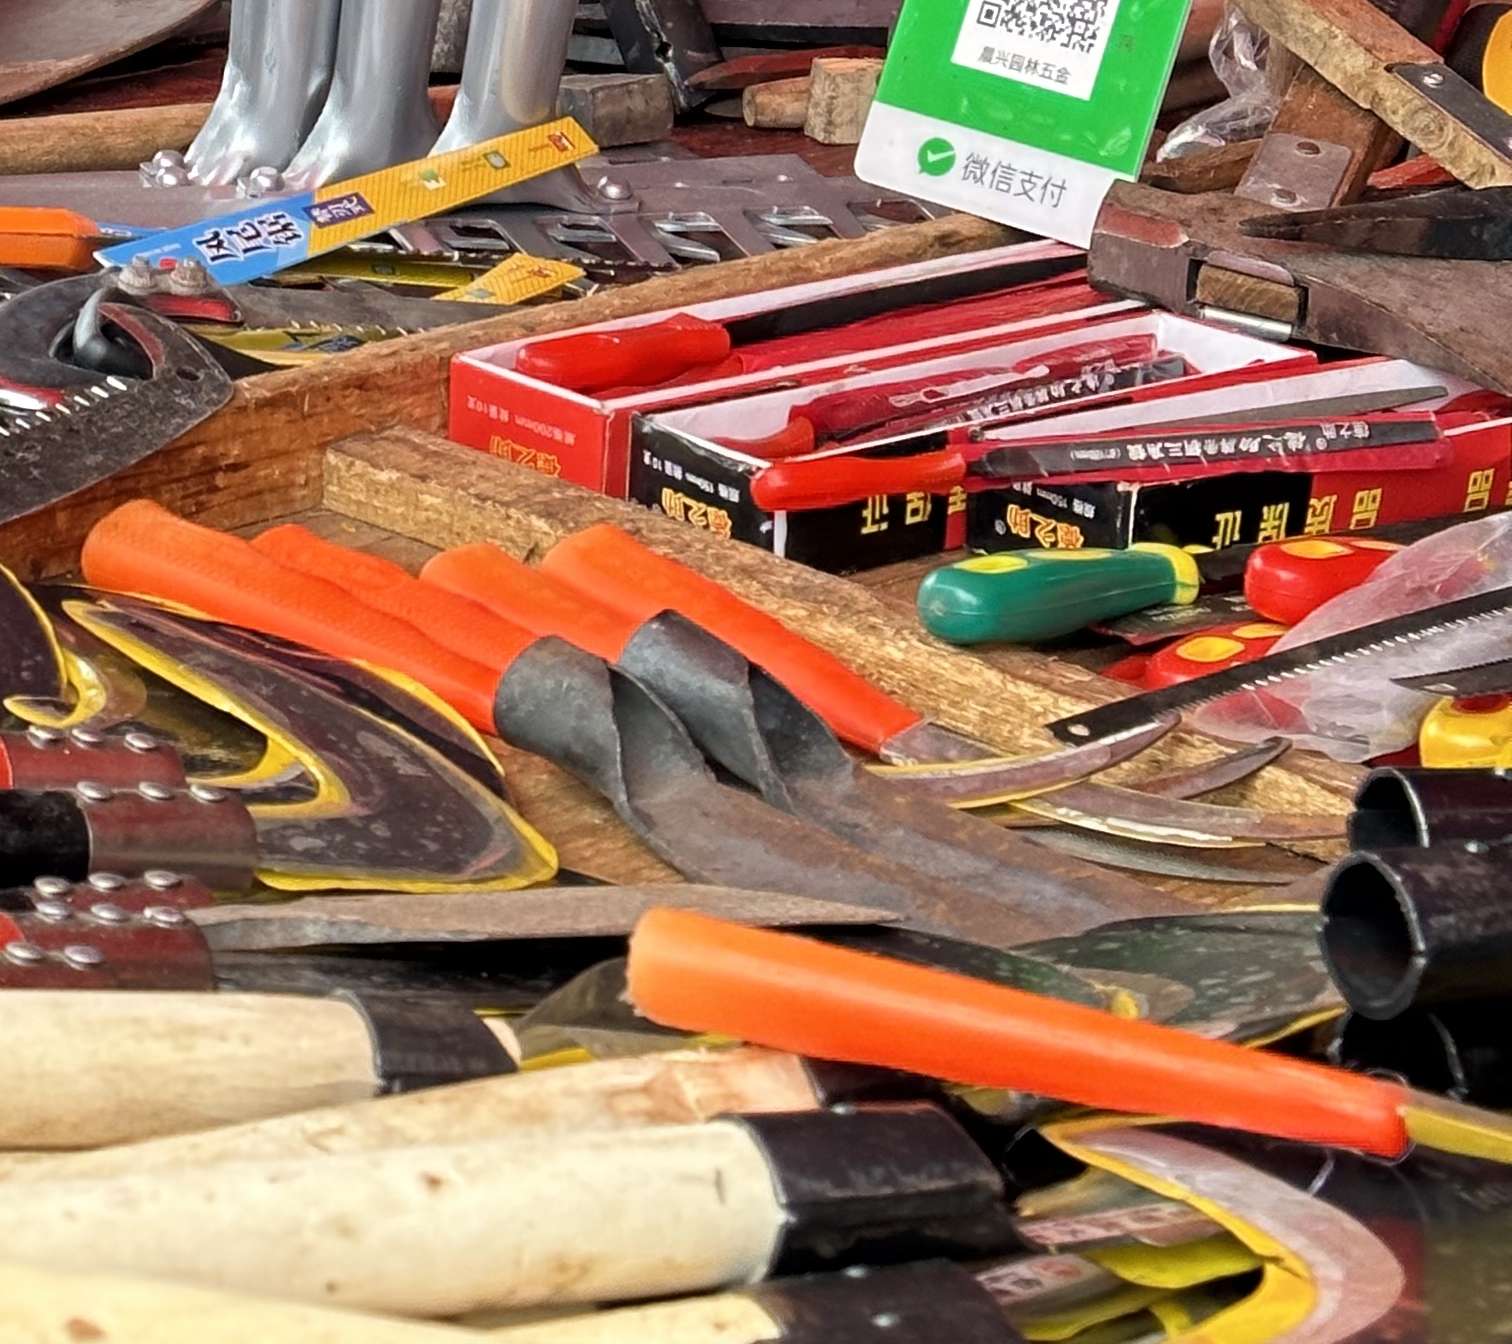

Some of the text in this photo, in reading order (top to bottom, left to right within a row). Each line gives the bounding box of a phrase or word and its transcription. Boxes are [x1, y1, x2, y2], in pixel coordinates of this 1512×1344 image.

[961, 152, 1068, 210] 微信支付
[1006, 503, 1084, 549] 德之助
